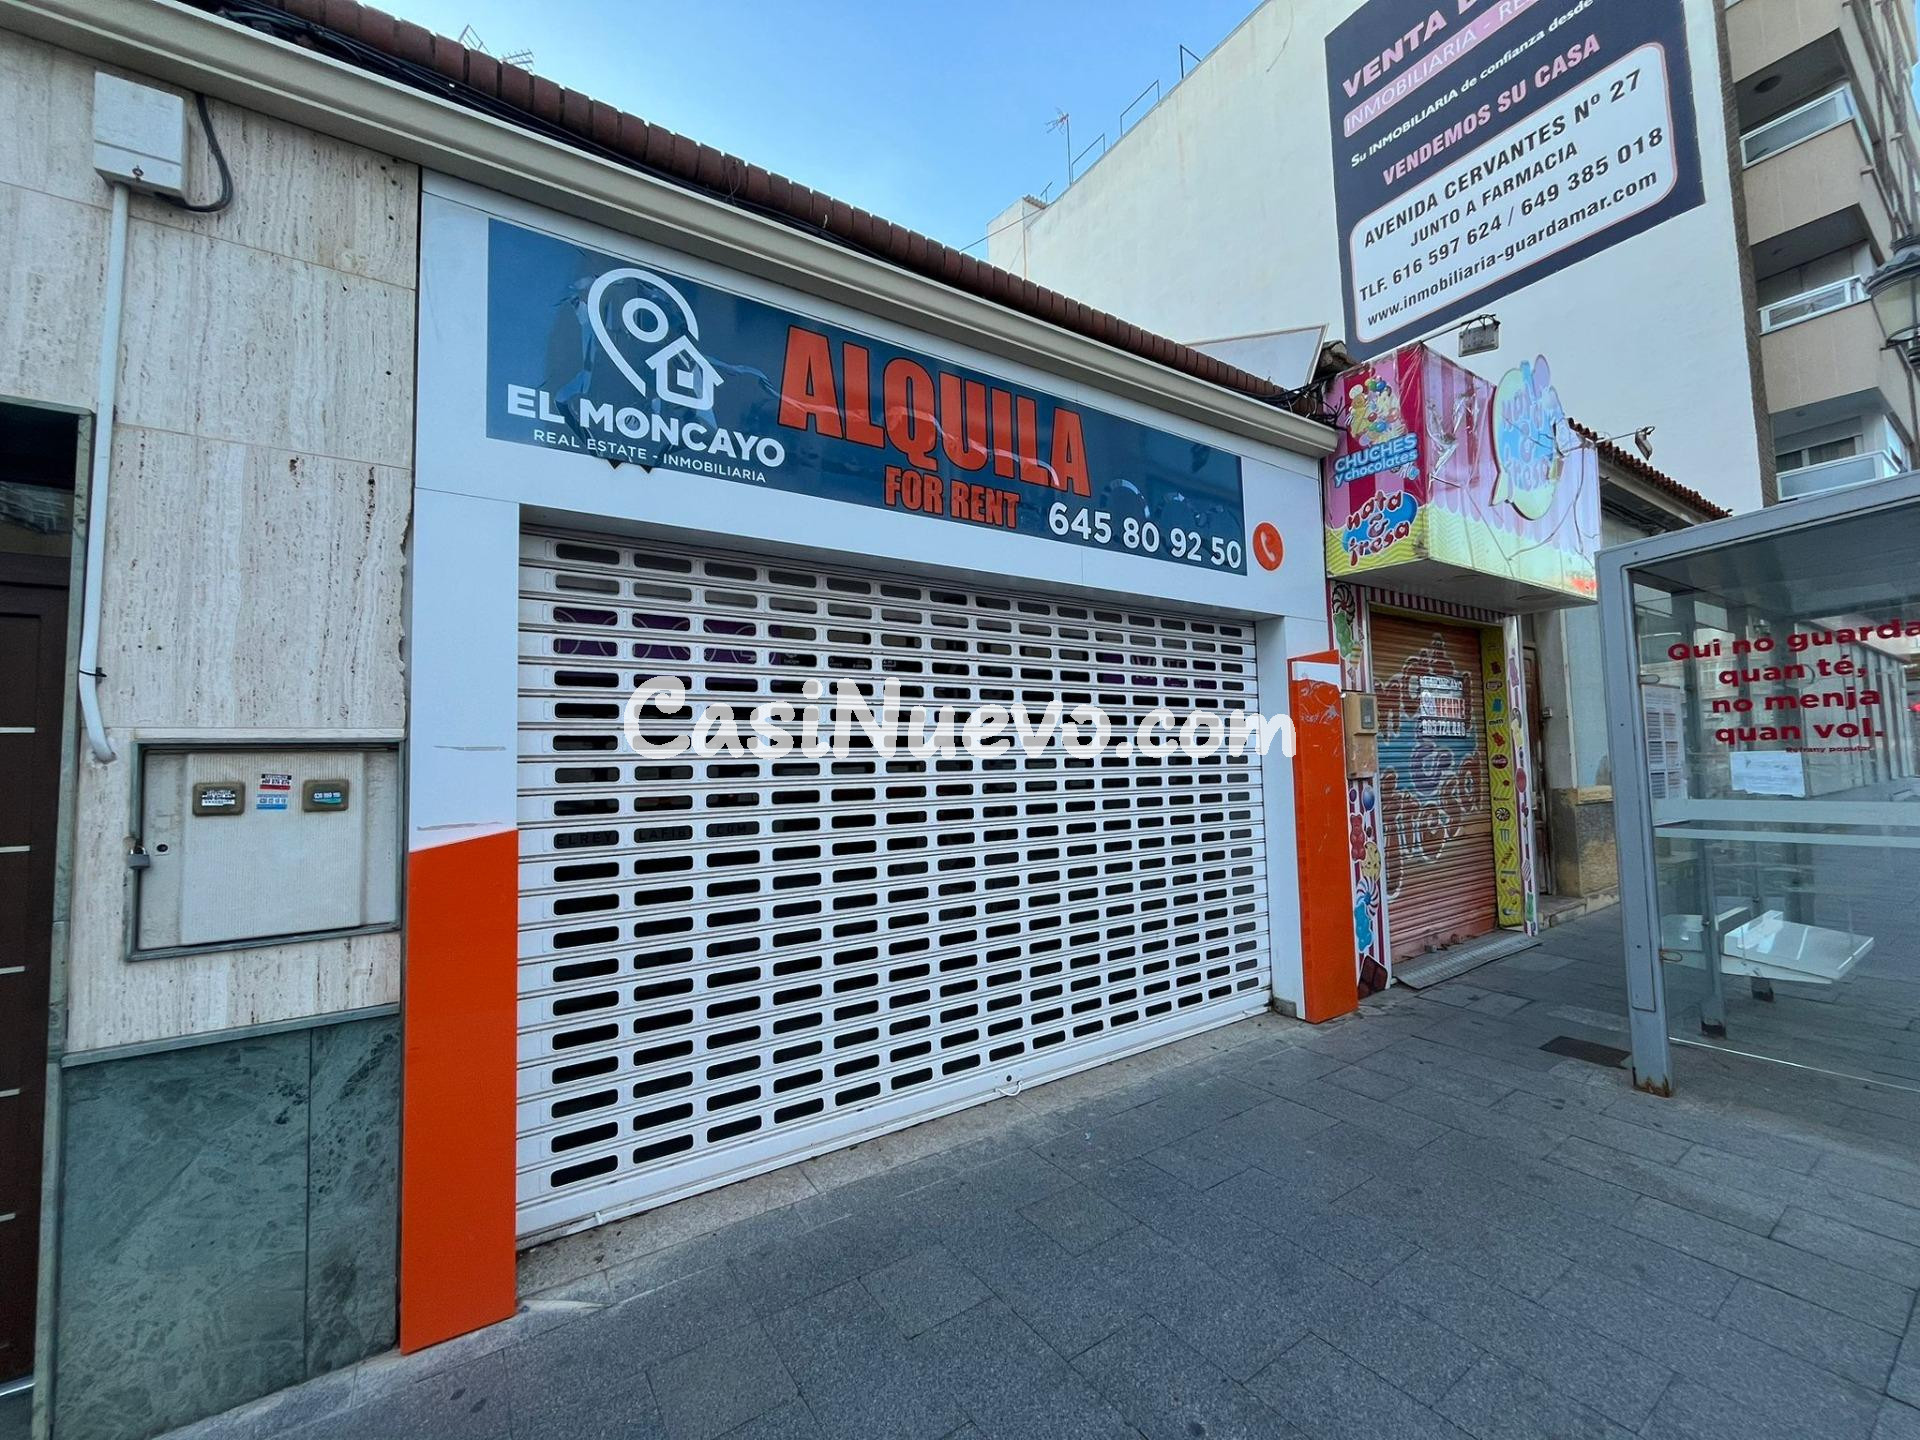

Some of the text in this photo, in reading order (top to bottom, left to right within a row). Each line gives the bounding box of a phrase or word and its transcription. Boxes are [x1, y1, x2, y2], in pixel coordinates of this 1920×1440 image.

[1342, 9, 1447, 98] VENTA
[1346, 29, 1477, 131] INMOBILIARIA
[1368, 88, 1459, 157] INMOBILIARIA
[1460, 76, 1478, 93] de
[1480, 30, 1546, 79] confianza
[1382, 33, 1600, 186] VENDEMOS SU CASA
[1364, 193, 1439, 248] AVENIDA
[1444, 115, 1566, 197] CERVANTES
[1610, 68, 1642, 104] 27
[1359, 278, 1388, 303] TLF.
[1392, 258, 1423, 285] 616
[1428, 239, 1461, 271] 597
[1466, 219, 1502, 252] 624
[1520, 184, 1560, 217] 649
[1567, 157, 1609, 191] 385
[1617, 127, 1664, 165] 018
[1410, 142, 1578, 247] JUNTO A FARMACIA
[1367, 171, 1658, 327] www.inmobiliaria-guardamar.com
[507, 383, 786, 468] EL MONCAYO
[777, 325, 1092, 498] ALQUILA
[533, 429, 580, 449] REAL
[586, 437, 647, 460] ESTATE
[663, 454, 767, 483] INMOBILIARIA
[1334, 433, 1418, 472] CHUCHES
[1334, 448, 1418, 488] y chocolates
[883, 465, 1022, 529] FOR RENT
[1347, 490, 1402, 530] nata
[1048, 502, 1242, 569] 645 80 92 50
[1348, 521, 1410, 567] fresa
[1667, 617, 1920, 661] Qui no guarda
[1718, 655, 1868, 687] quan té,
[1712, 686, 1881, 714] no menja
[1715, 718, 1885, 746] quan vol.
